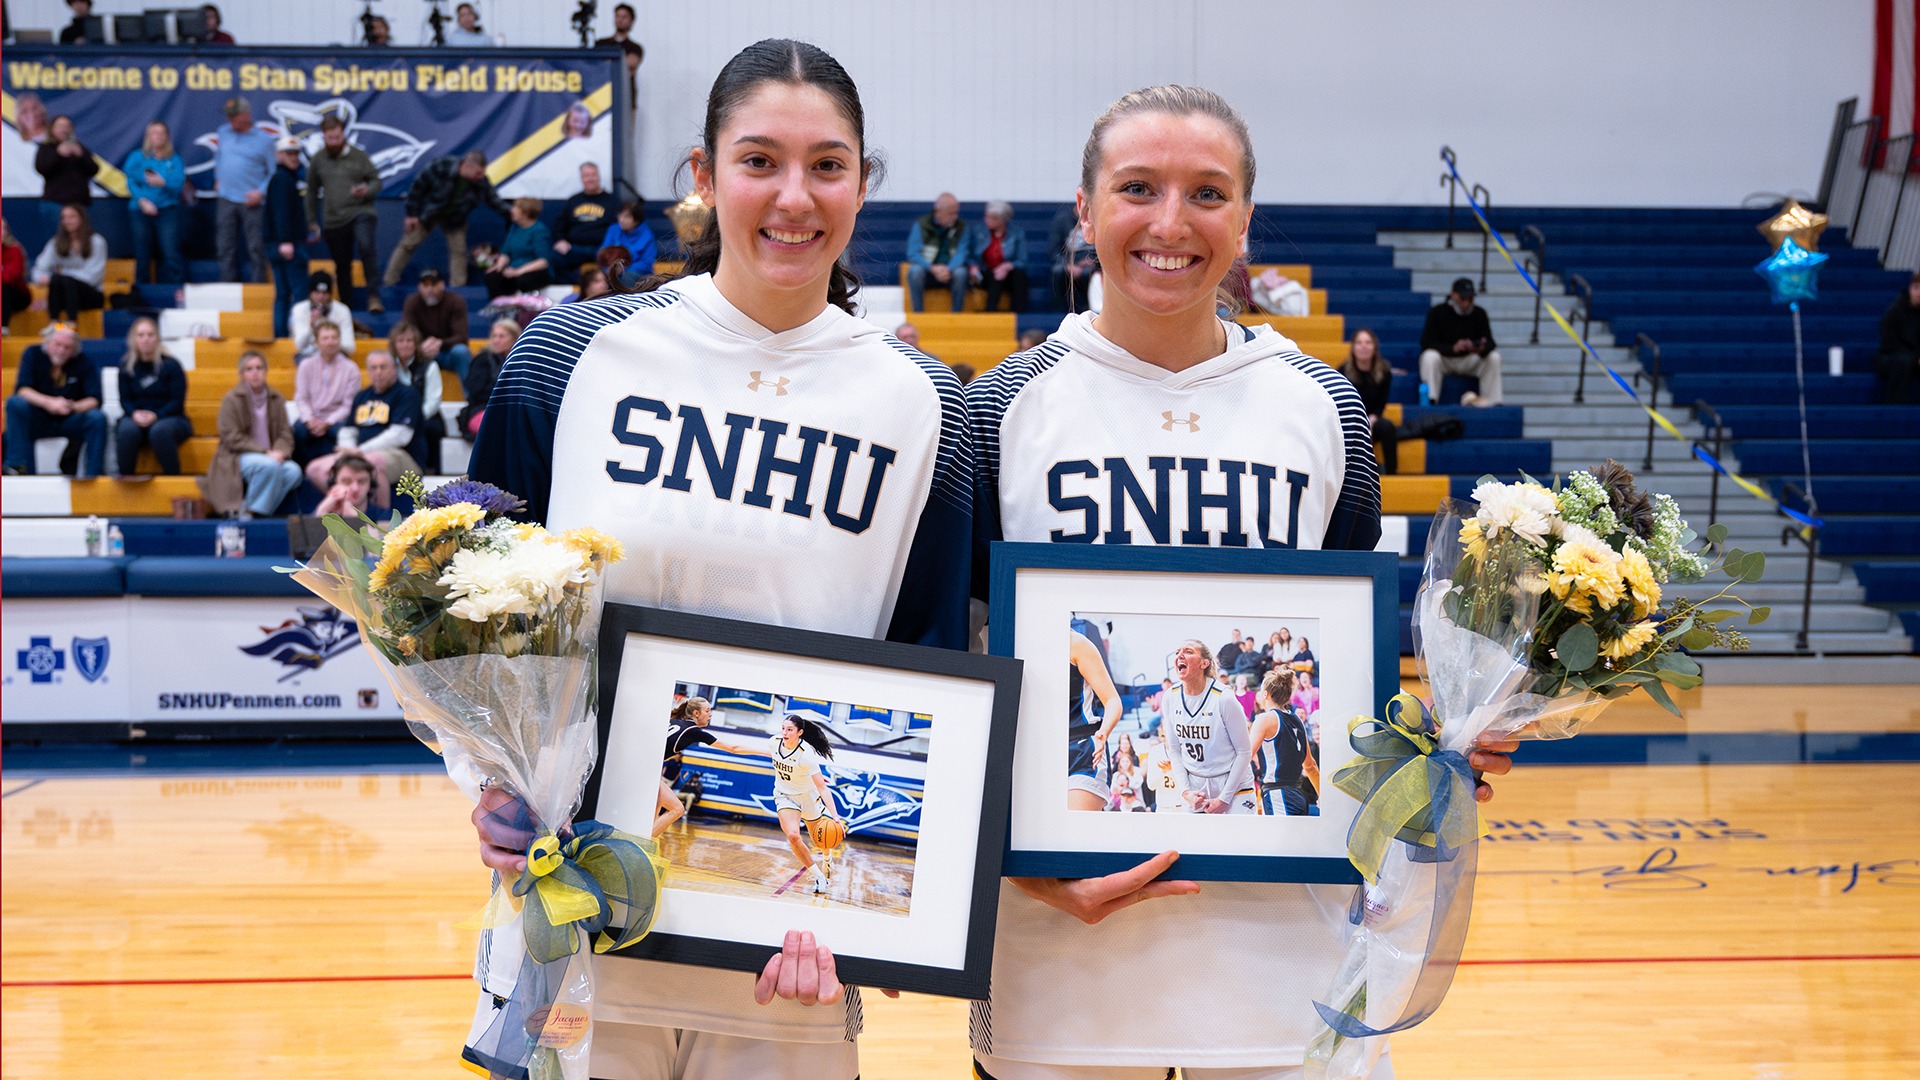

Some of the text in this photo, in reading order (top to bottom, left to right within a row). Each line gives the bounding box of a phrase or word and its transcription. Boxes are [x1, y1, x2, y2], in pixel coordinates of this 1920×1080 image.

[9, 61, 582, 95] Welcome to the Stan Spirou Field House
[605, 395, 898, 536] SNHU
[1046, 455, 1310, 549] SNHU
[158, 692, 342, 709] SNHUPenmen.com
[1176, 723, 1210, 740] SNHU
[1185, 742, 1205, 762] 20
[550, 1009, 588, 1026] Jacques
